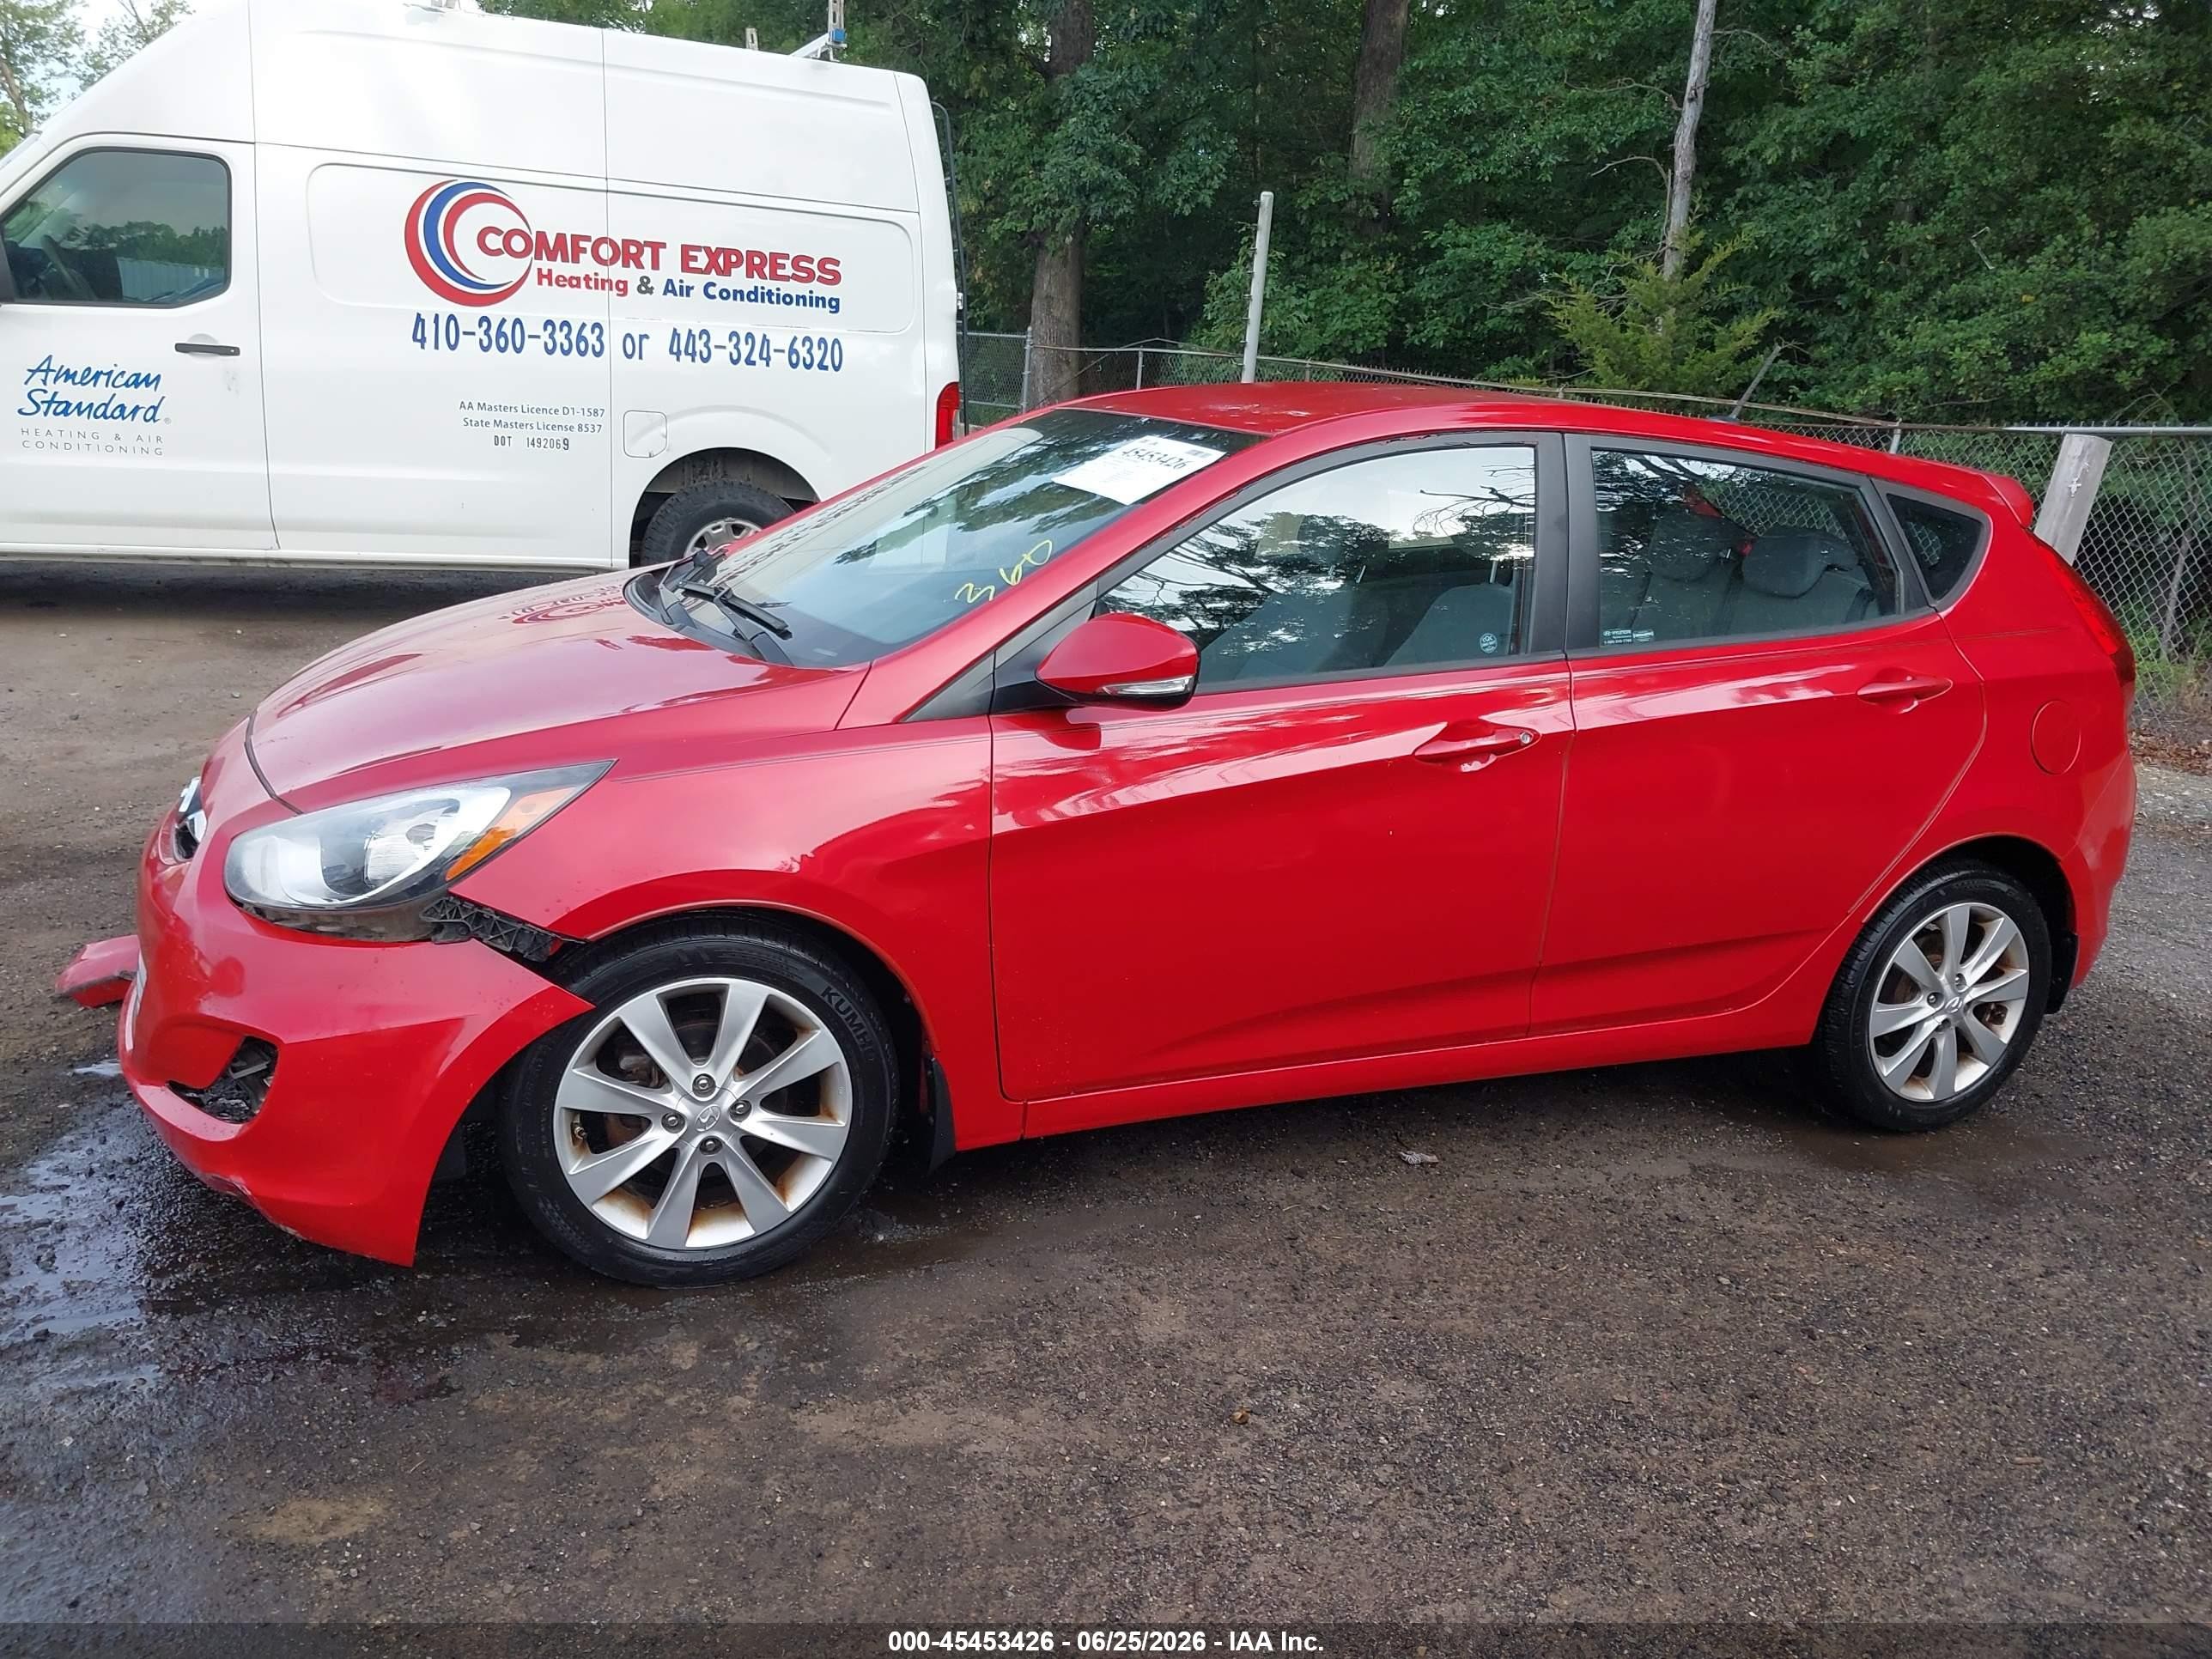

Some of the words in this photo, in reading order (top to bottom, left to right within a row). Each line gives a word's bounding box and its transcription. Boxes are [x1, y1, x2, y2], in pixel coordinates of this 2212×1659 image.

[477, 226, 666, 271] COMFORT
[680, 244, 842, 286] EXPRESS
[537, 268, 628, 296] Heating
[636, 276, 654, 295] &
[663, 278, 695, 297] Air
[703, 283, 841, 313] Conditioning
[412, 313, 605, 357] 410-360-3363
[623, 332, 650, 360] or
[669, 327, 843, 372] 443-324-6320
[24, 355, 161, 392] American
[17, 389, 166, 423] Standard
[459, 401, 474, 410] AA
[477, 402, 518, 413] Masters
[521, 404, 559, 416] Licence
[562, 407, 605, 417] D1-1587
[21, 428, 100, 441] HEATING
[136, 434, 163, 443] AIR
[463, 417, 490, 428] State
[493, 419, 534, 430] Masters
[537, 422, 574, 432] License
[577, 423, 602, 433] 8537
[21, 441, 163, 456] CONDITIONING
[494, 435, 512, 447] DOT
[526, 437, 569, 450] 1492069
[955, 540, 1053, 604] 360
